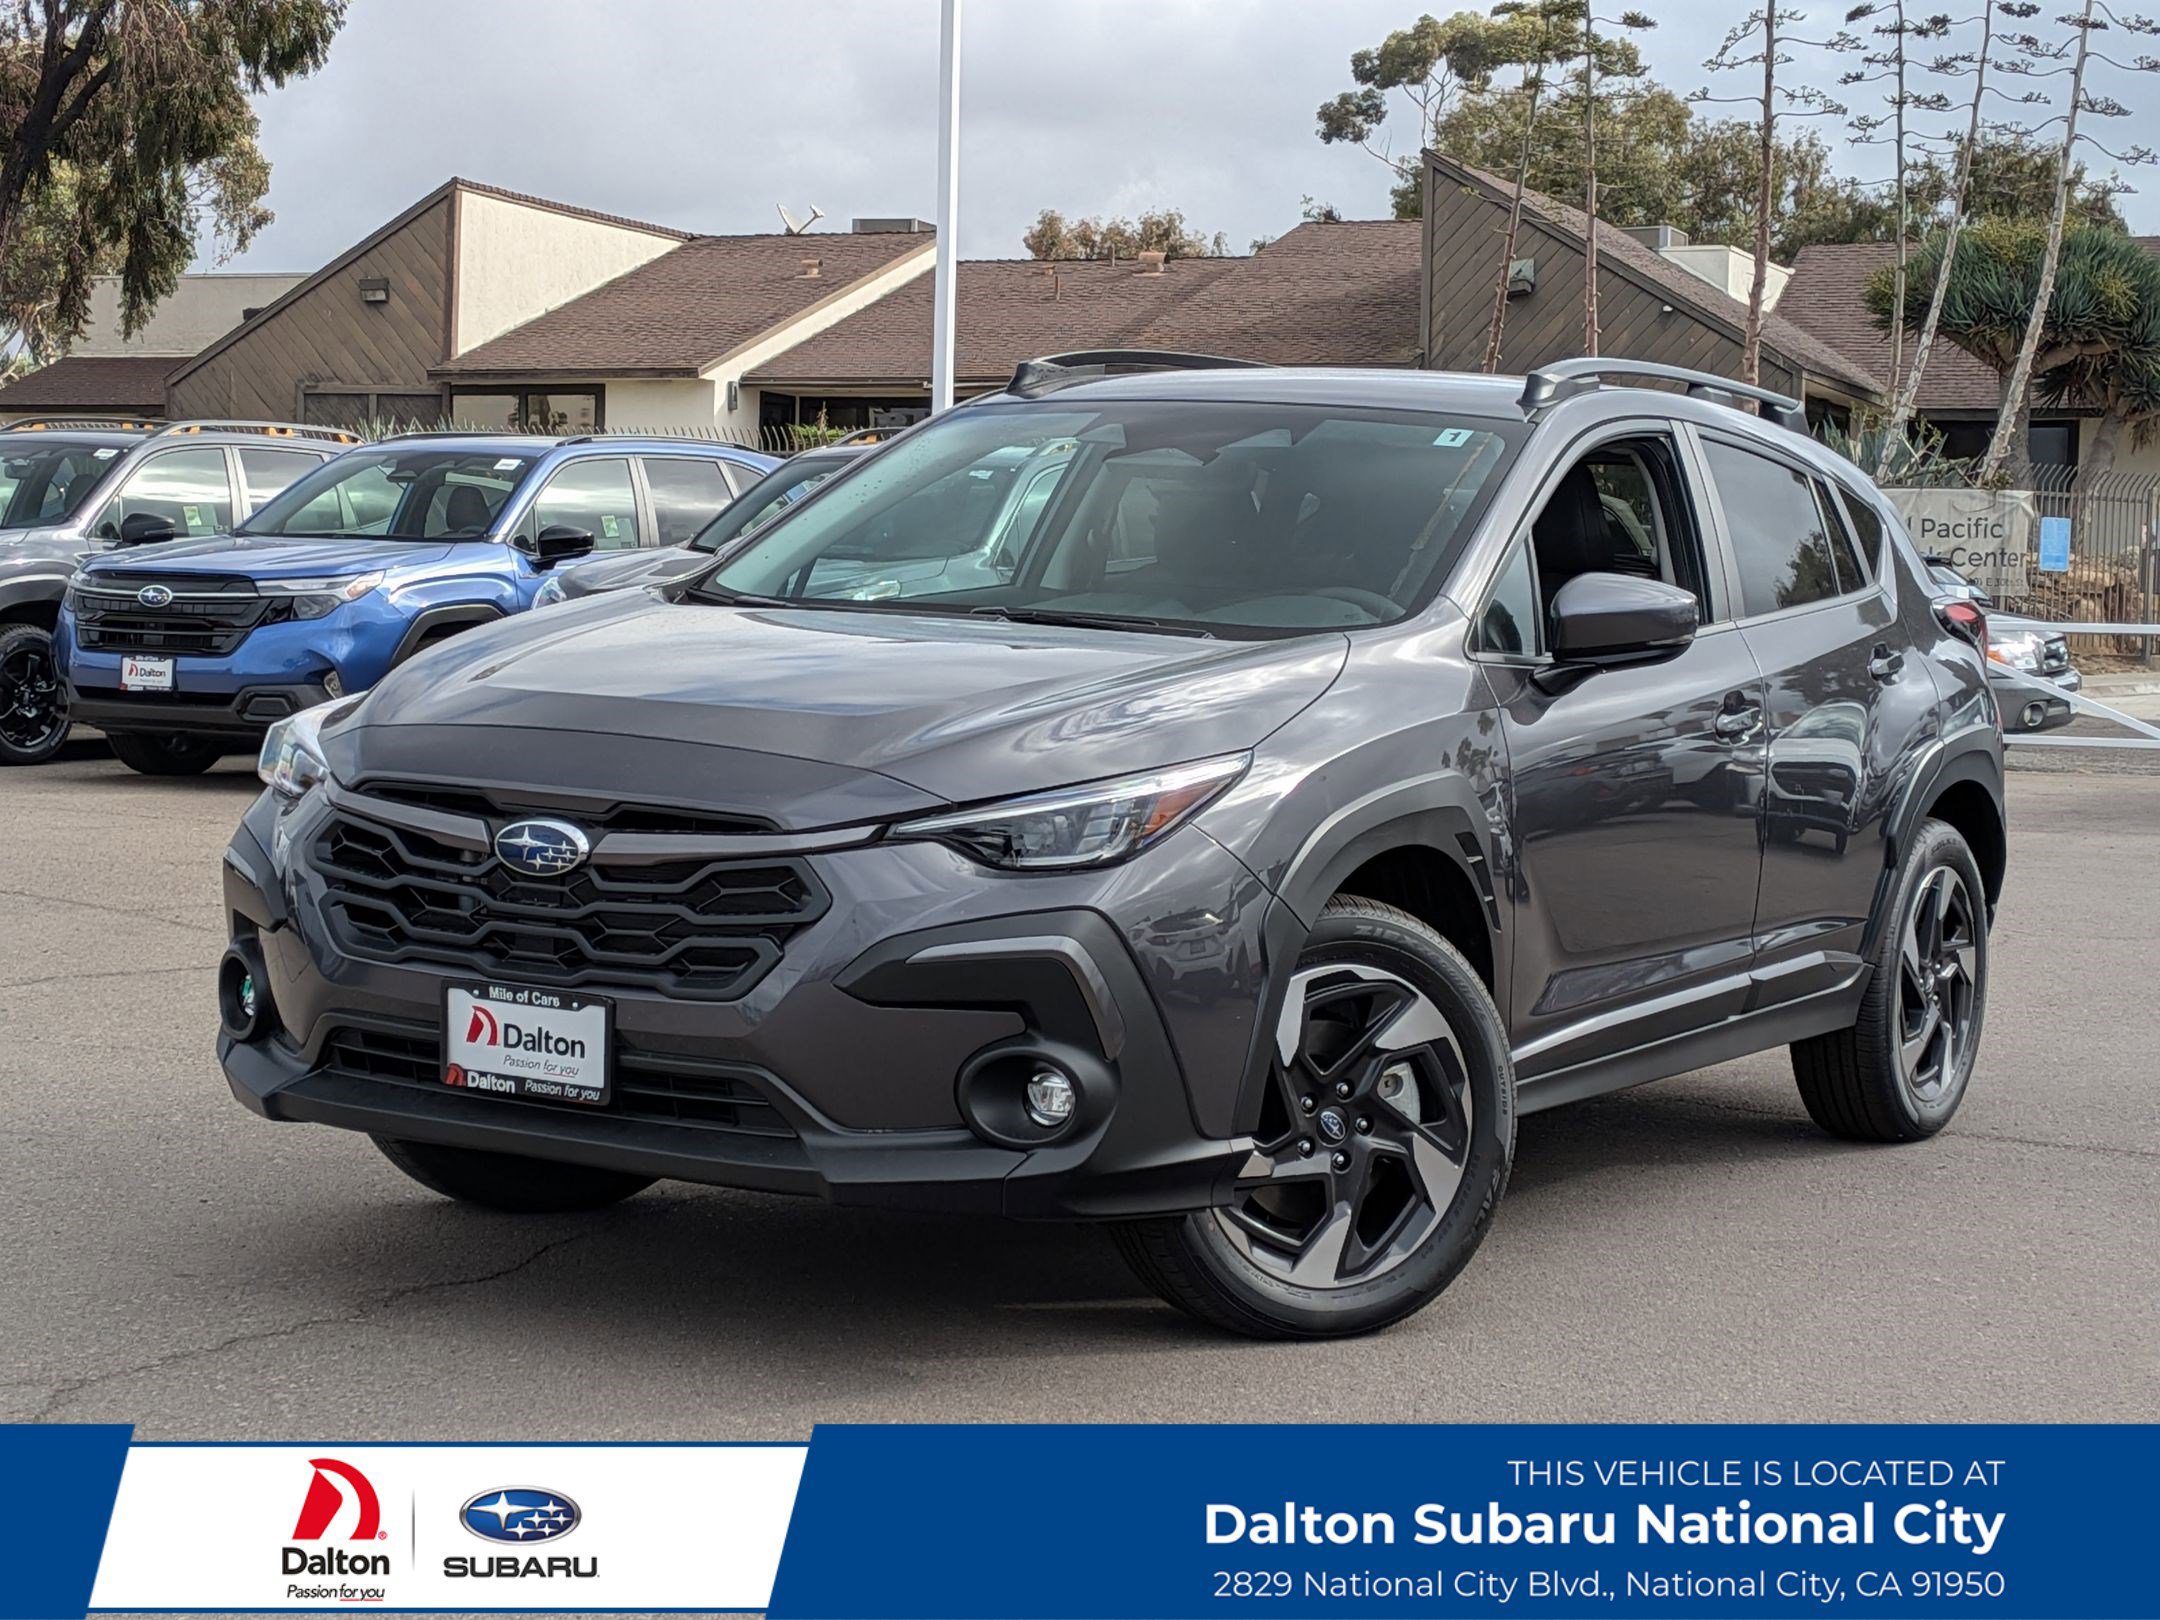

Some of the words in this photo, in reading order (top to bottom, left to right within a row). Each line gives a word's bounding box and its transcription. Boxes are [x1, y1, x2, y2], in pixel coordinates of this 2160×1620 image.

[1449, 431, 1462, 442] 1
[1921, 517, 2003, 538] Pacific
[1951, 547, 2027, 567] Center
[489, 985, 513, 1001] Mile
[516, 990, 529, 1003] of
[532, 991, 560, 1007] Cars
[503, 1023, 585, 1058] Dalton
[503, 1055, 540, 1070] Passion
[544, 1060, 557, 1072] for
[560, 1065, 579, 1076] you
[467, 1070, 515, 1094] Dalton
[525, 1079, 561, 1095] Passion
[564, 1085, 578, 1097] for
[580, 1088, 600, 1101] you
